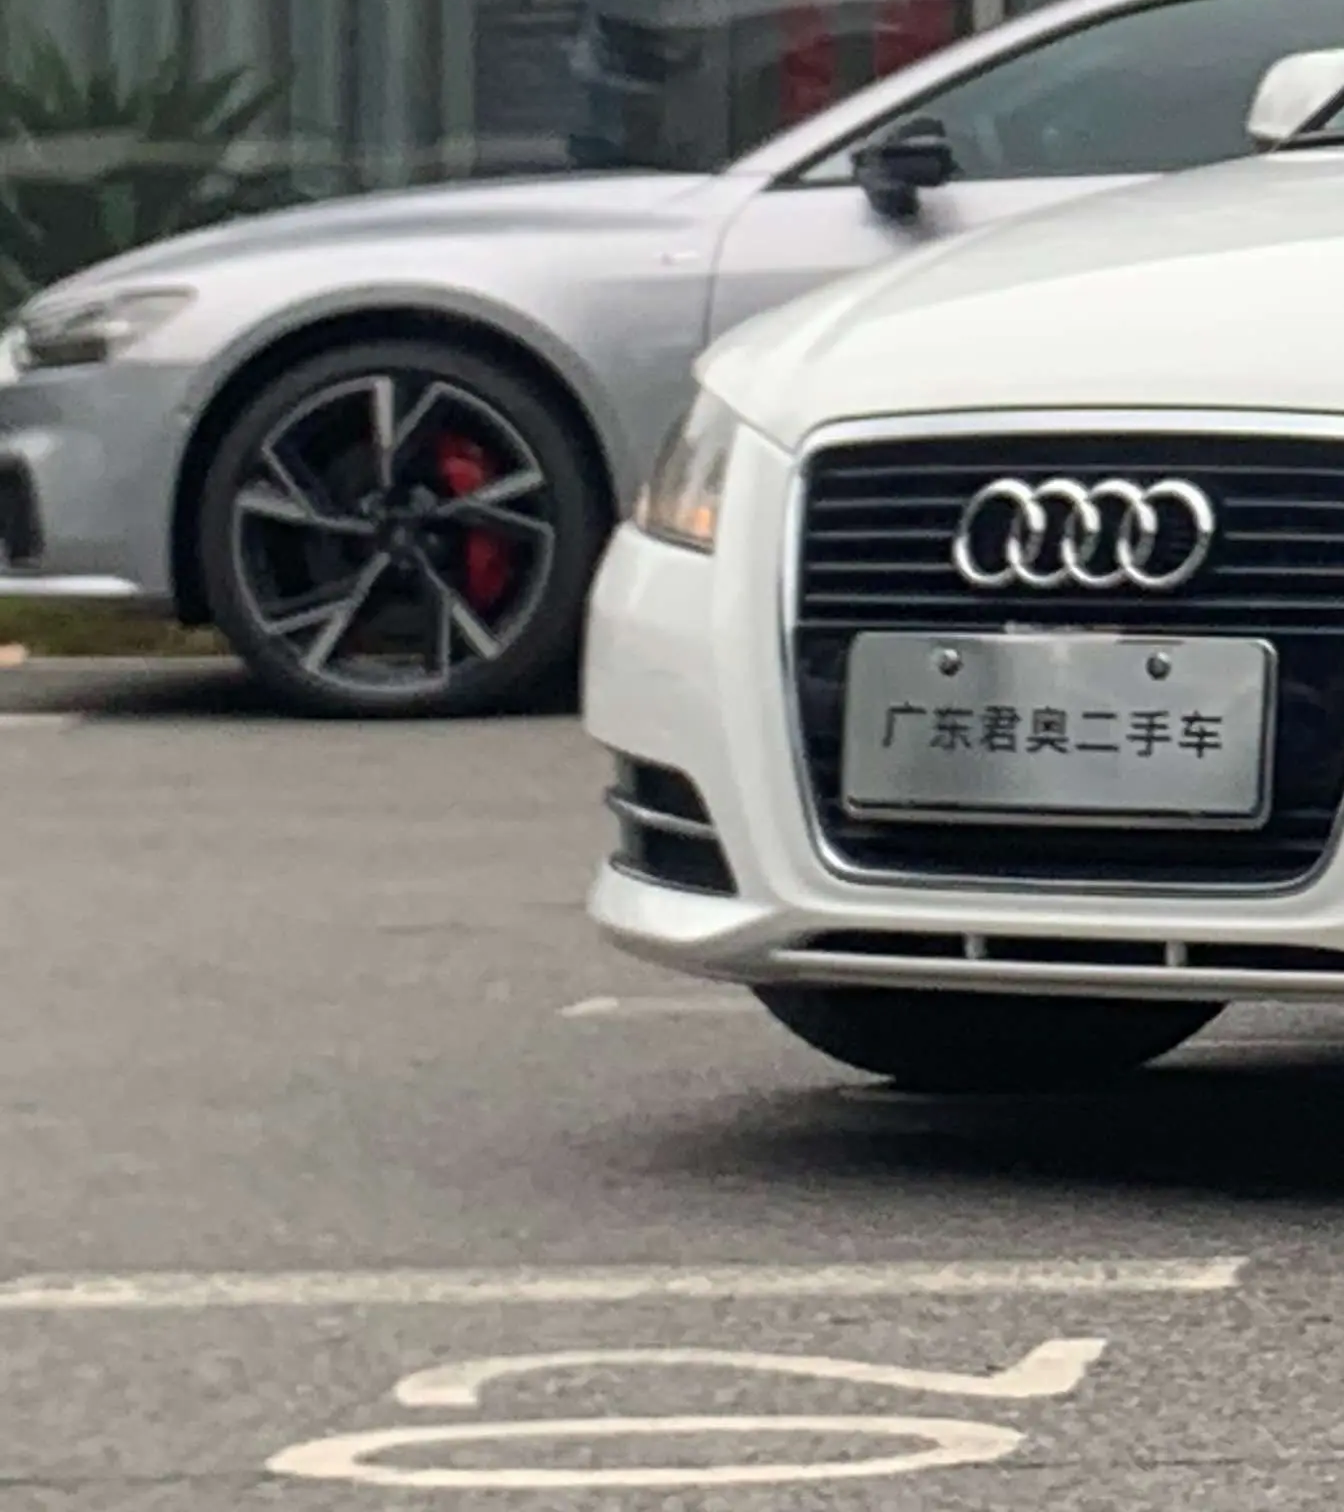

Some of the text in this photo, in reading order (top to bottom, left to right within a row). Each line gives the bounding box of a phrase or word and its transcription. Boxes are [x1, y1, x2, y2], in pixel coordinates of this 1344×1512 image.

[881, 701, 1223, 758] 广东君奥二手车
